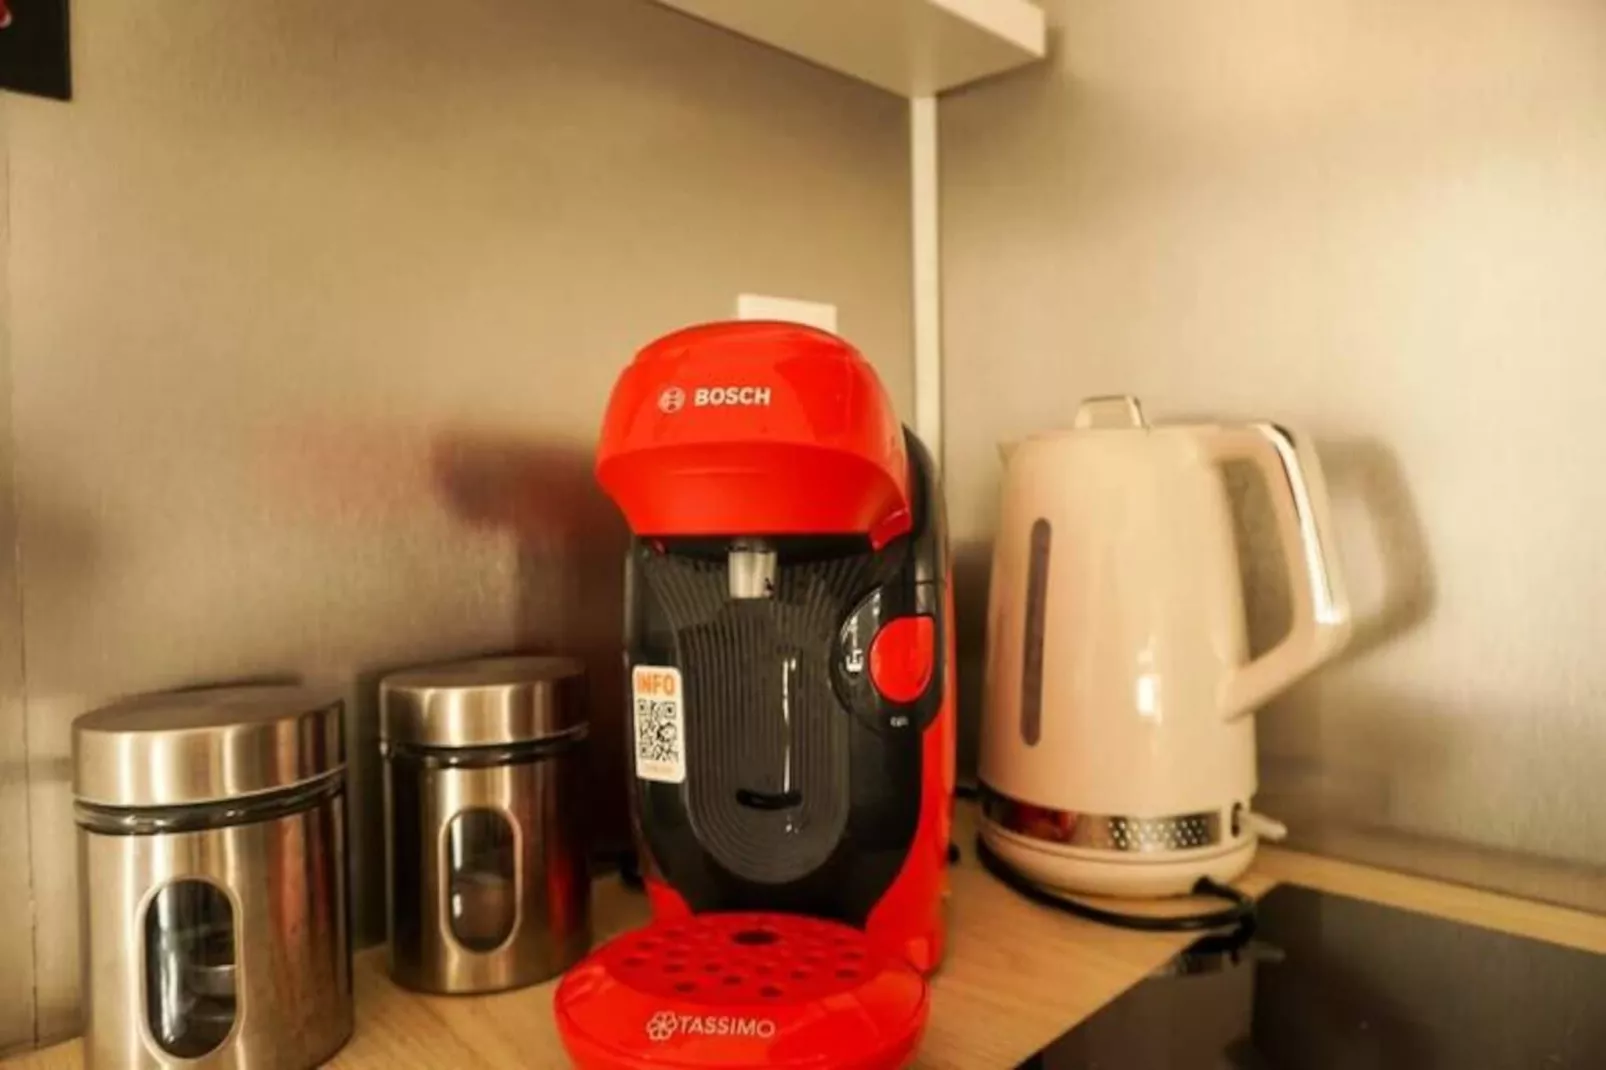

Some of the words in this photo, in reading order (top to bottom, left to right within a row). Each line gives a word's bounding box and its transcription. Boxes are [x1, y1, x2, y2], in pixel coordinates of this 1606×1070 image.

[694, 387, 771, 407] BOSCH
[636, 671, 676, 695] INFO
[678, 1016, 776, 1038] TASSIMO
